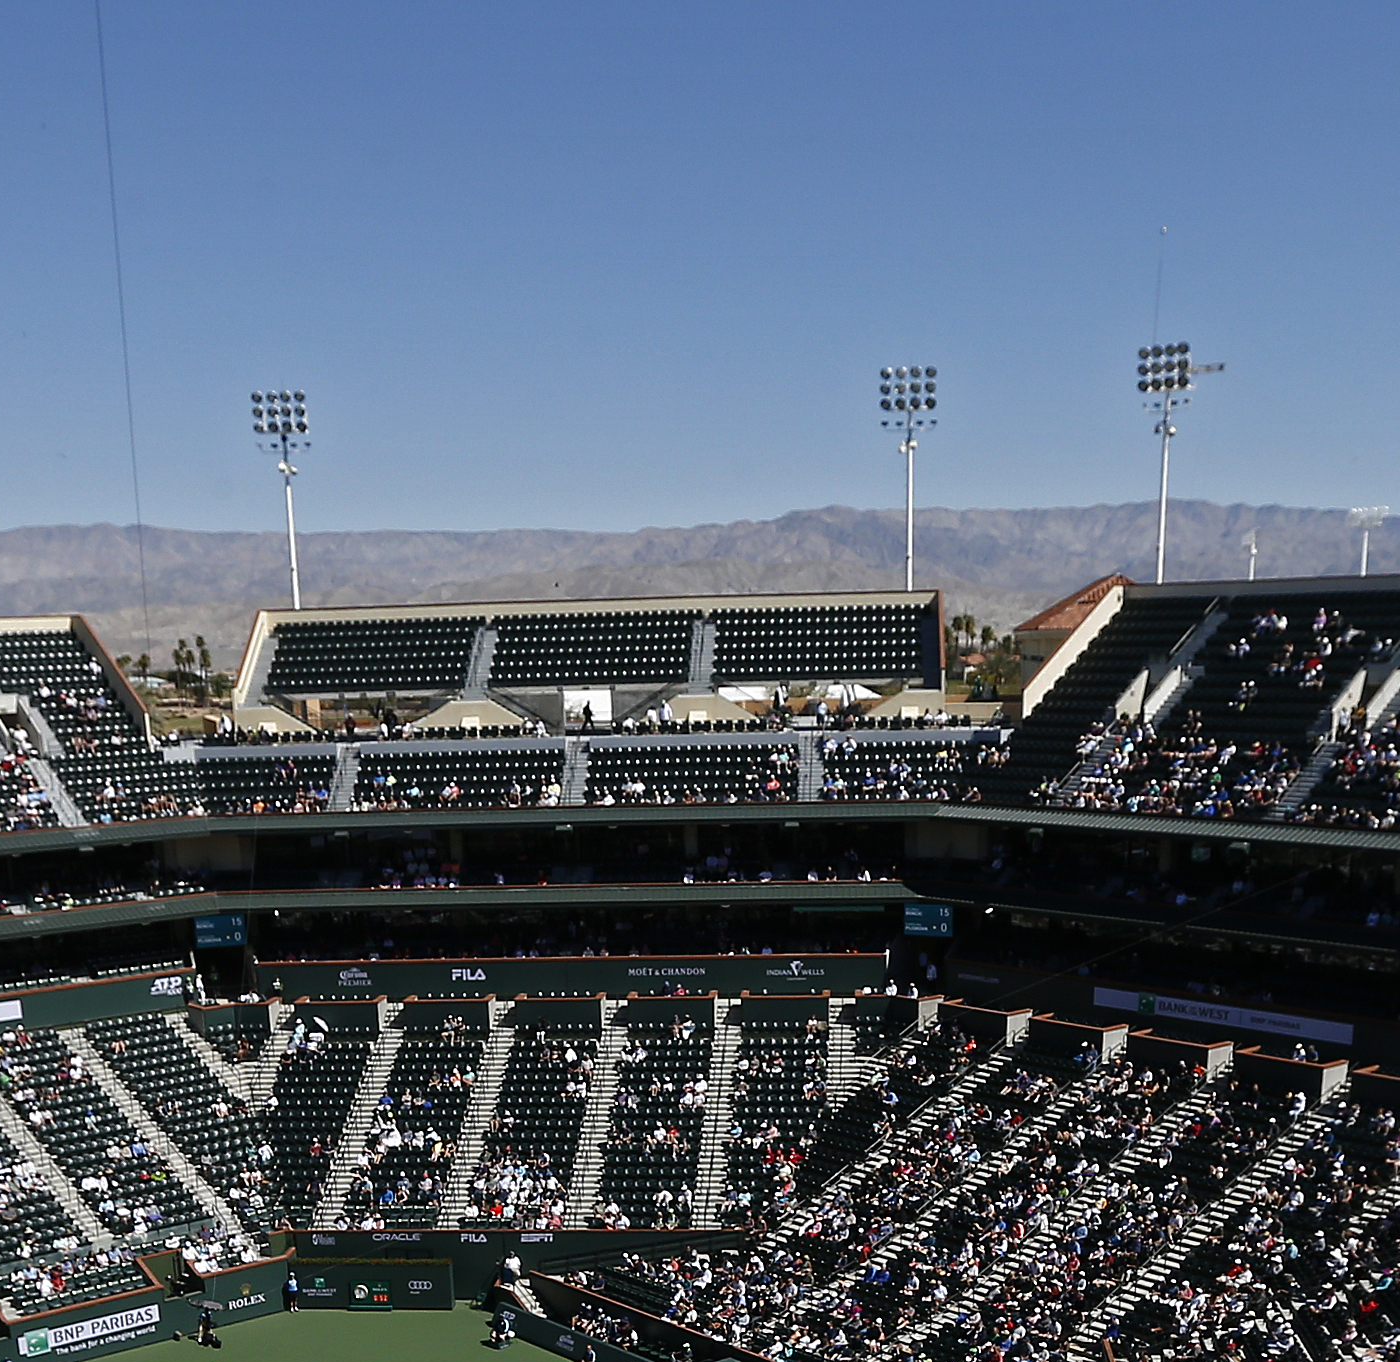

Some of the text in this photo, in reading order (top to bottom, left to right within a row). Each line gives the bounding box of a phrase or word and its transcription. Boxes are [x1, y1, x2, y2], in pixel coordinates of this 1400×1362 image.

[940, 908, 950, 917] 15
[231, 917, 242, 926] 15
[940, 923, 948, 933] 0
[234, 931, 242, 941] 0
[451, 968, 487, 981] FILA
[661, 968, 706, 976] CHANDON
[150, 976, 182, 991] ATP
[338, 979, 373, 987] PREMIER
[1158, 1000, 1190, 1016] BANK
[1198, 1006, 1230, 1021] WEST
[372, 1233, 422, 1241] ORACLE
[460, 1233, 488, 1243] FILA
[520, 1233, 554, 1242] ESPN
[228, 1293, 266, 1310] ROLEX
[53, 1308, 154, 1343] BNP PARIBAS
[56, 1347, 69, 1355] The
[70, 1342, 87, 1352] bank
[87, 1339, 99, 1349] for
[105, 1330, 136, 1344] changing
[136, 1325, 157, 1336] world
